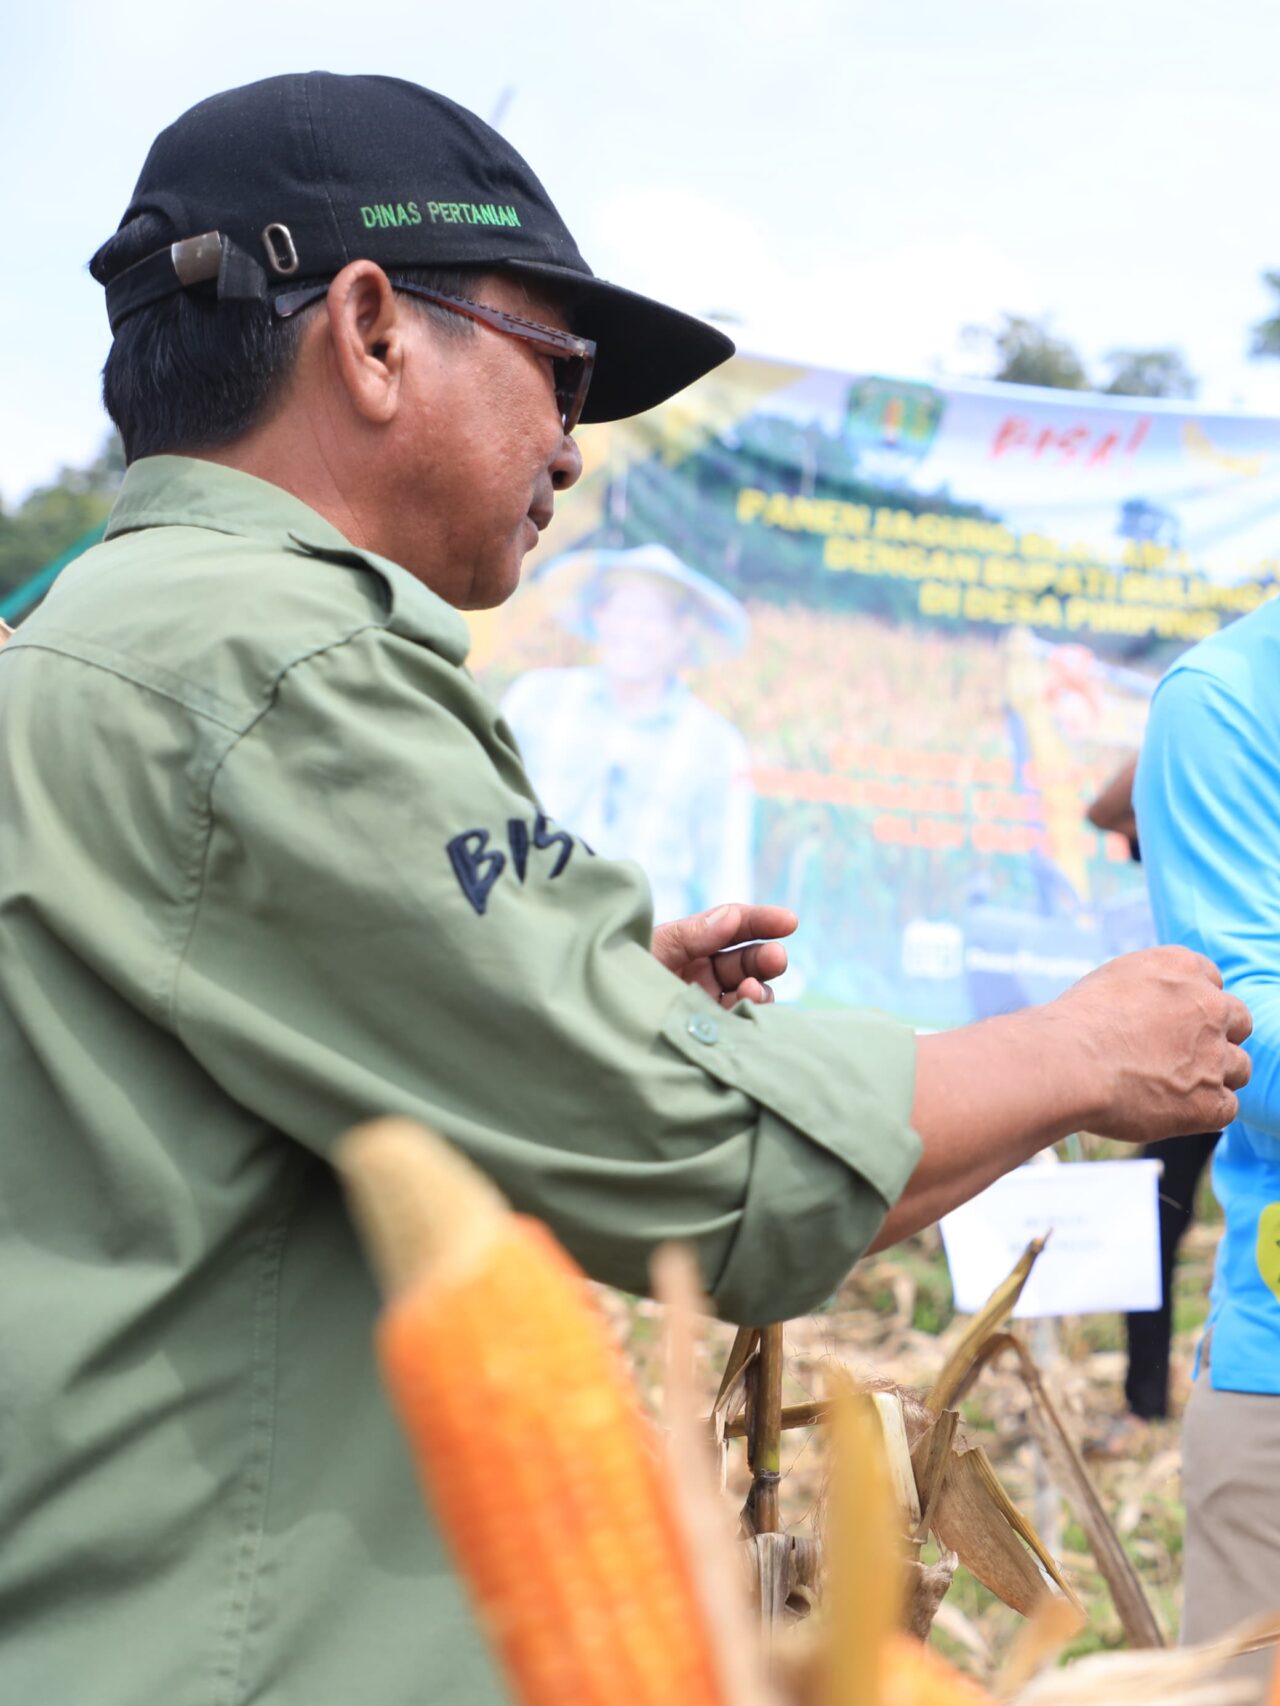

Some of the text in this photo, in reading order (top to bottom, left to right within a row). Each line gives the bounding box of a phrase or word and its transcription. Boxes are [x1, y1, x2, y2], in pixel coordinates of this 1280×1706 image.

[360, 201, 521, 228] DINAS PERTANIAN
[737, 488, 1015, 555] PANEN JAGUNG
[823, 535, 980, 581] DENGAN
[963, 584, 1061, 629] DESA
[446, 812, 595, 915] BIS
